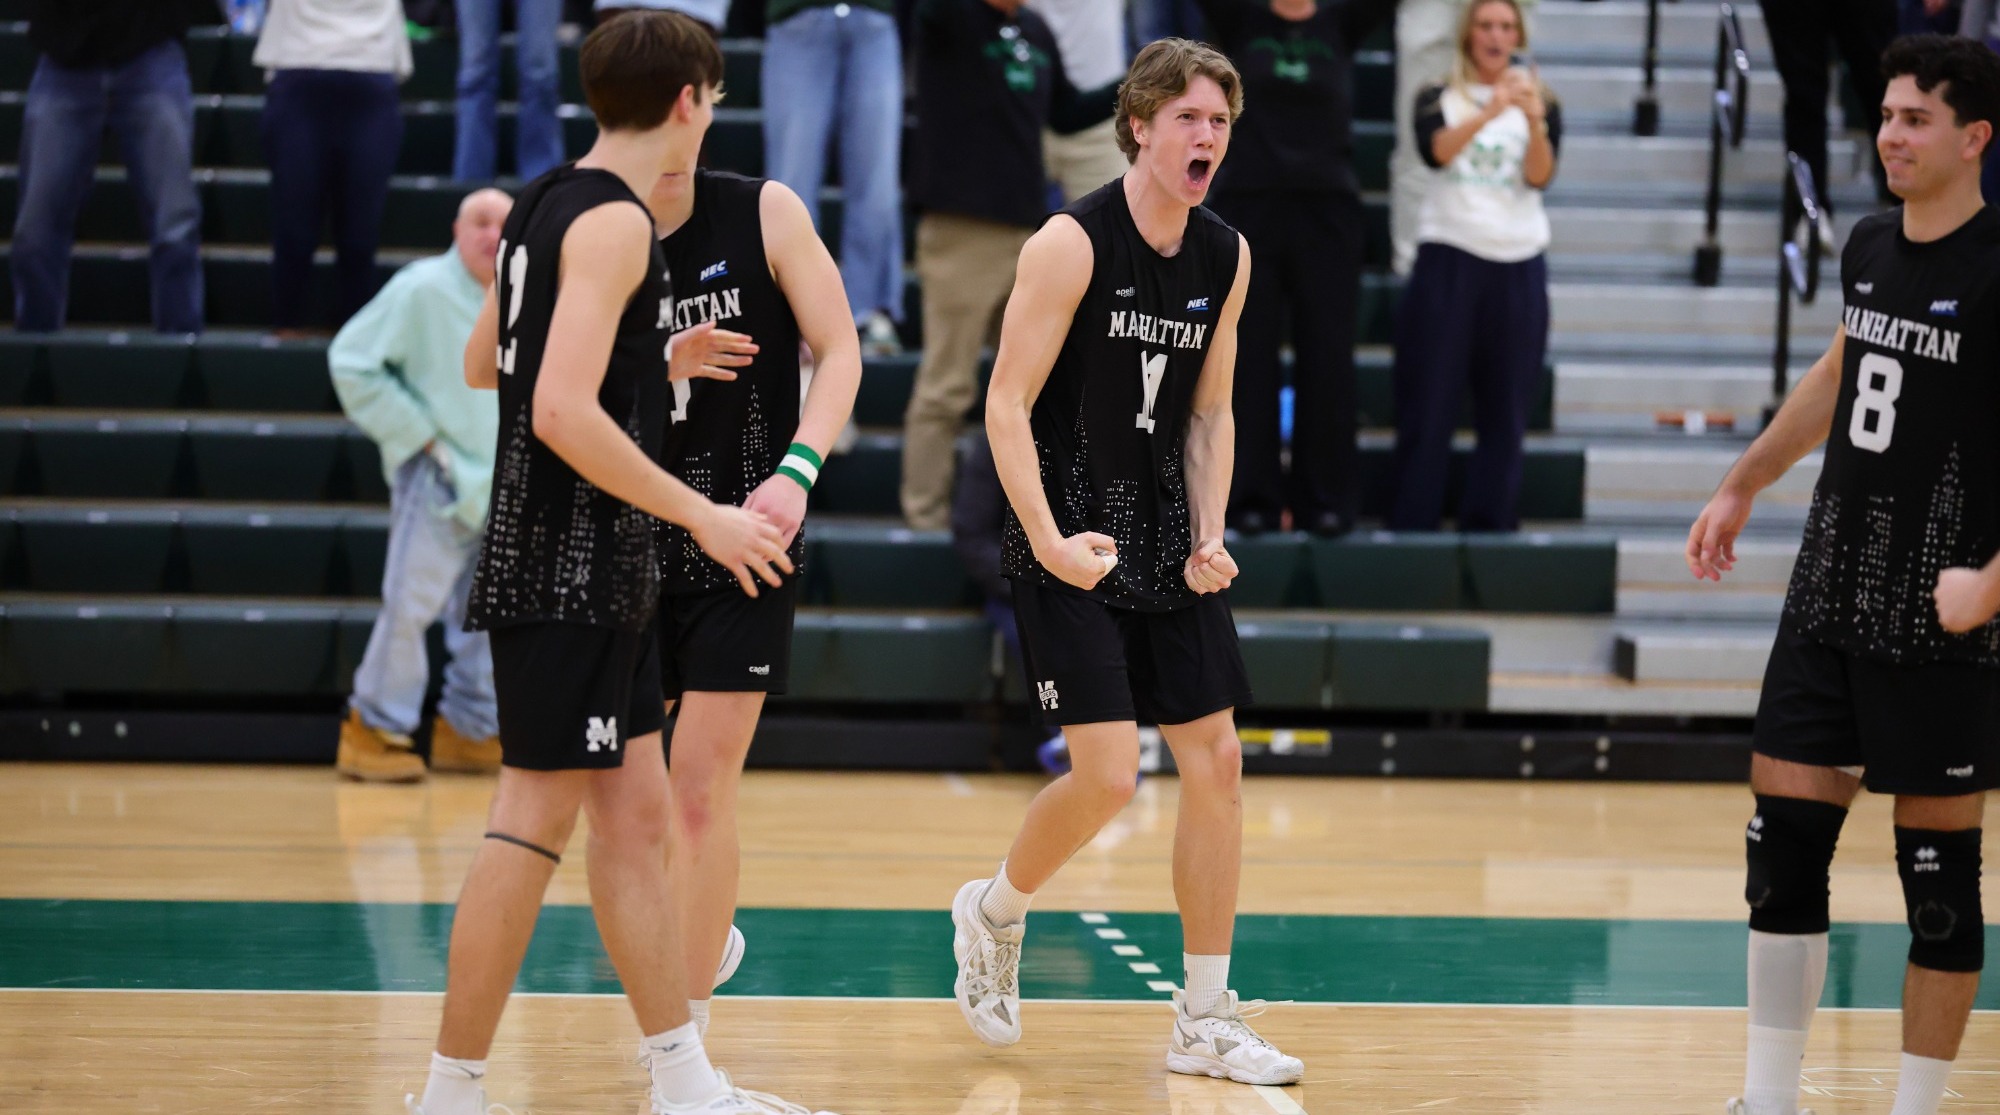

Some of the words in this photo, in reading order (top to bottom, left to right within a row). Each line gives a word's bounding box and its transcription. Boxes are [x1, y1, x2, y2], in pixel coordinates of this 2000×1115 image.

[700, 260, 728, 281] NEC
[1186, 297, 1209, 310] NEC
[1848, 351, 1904, 454] 8
